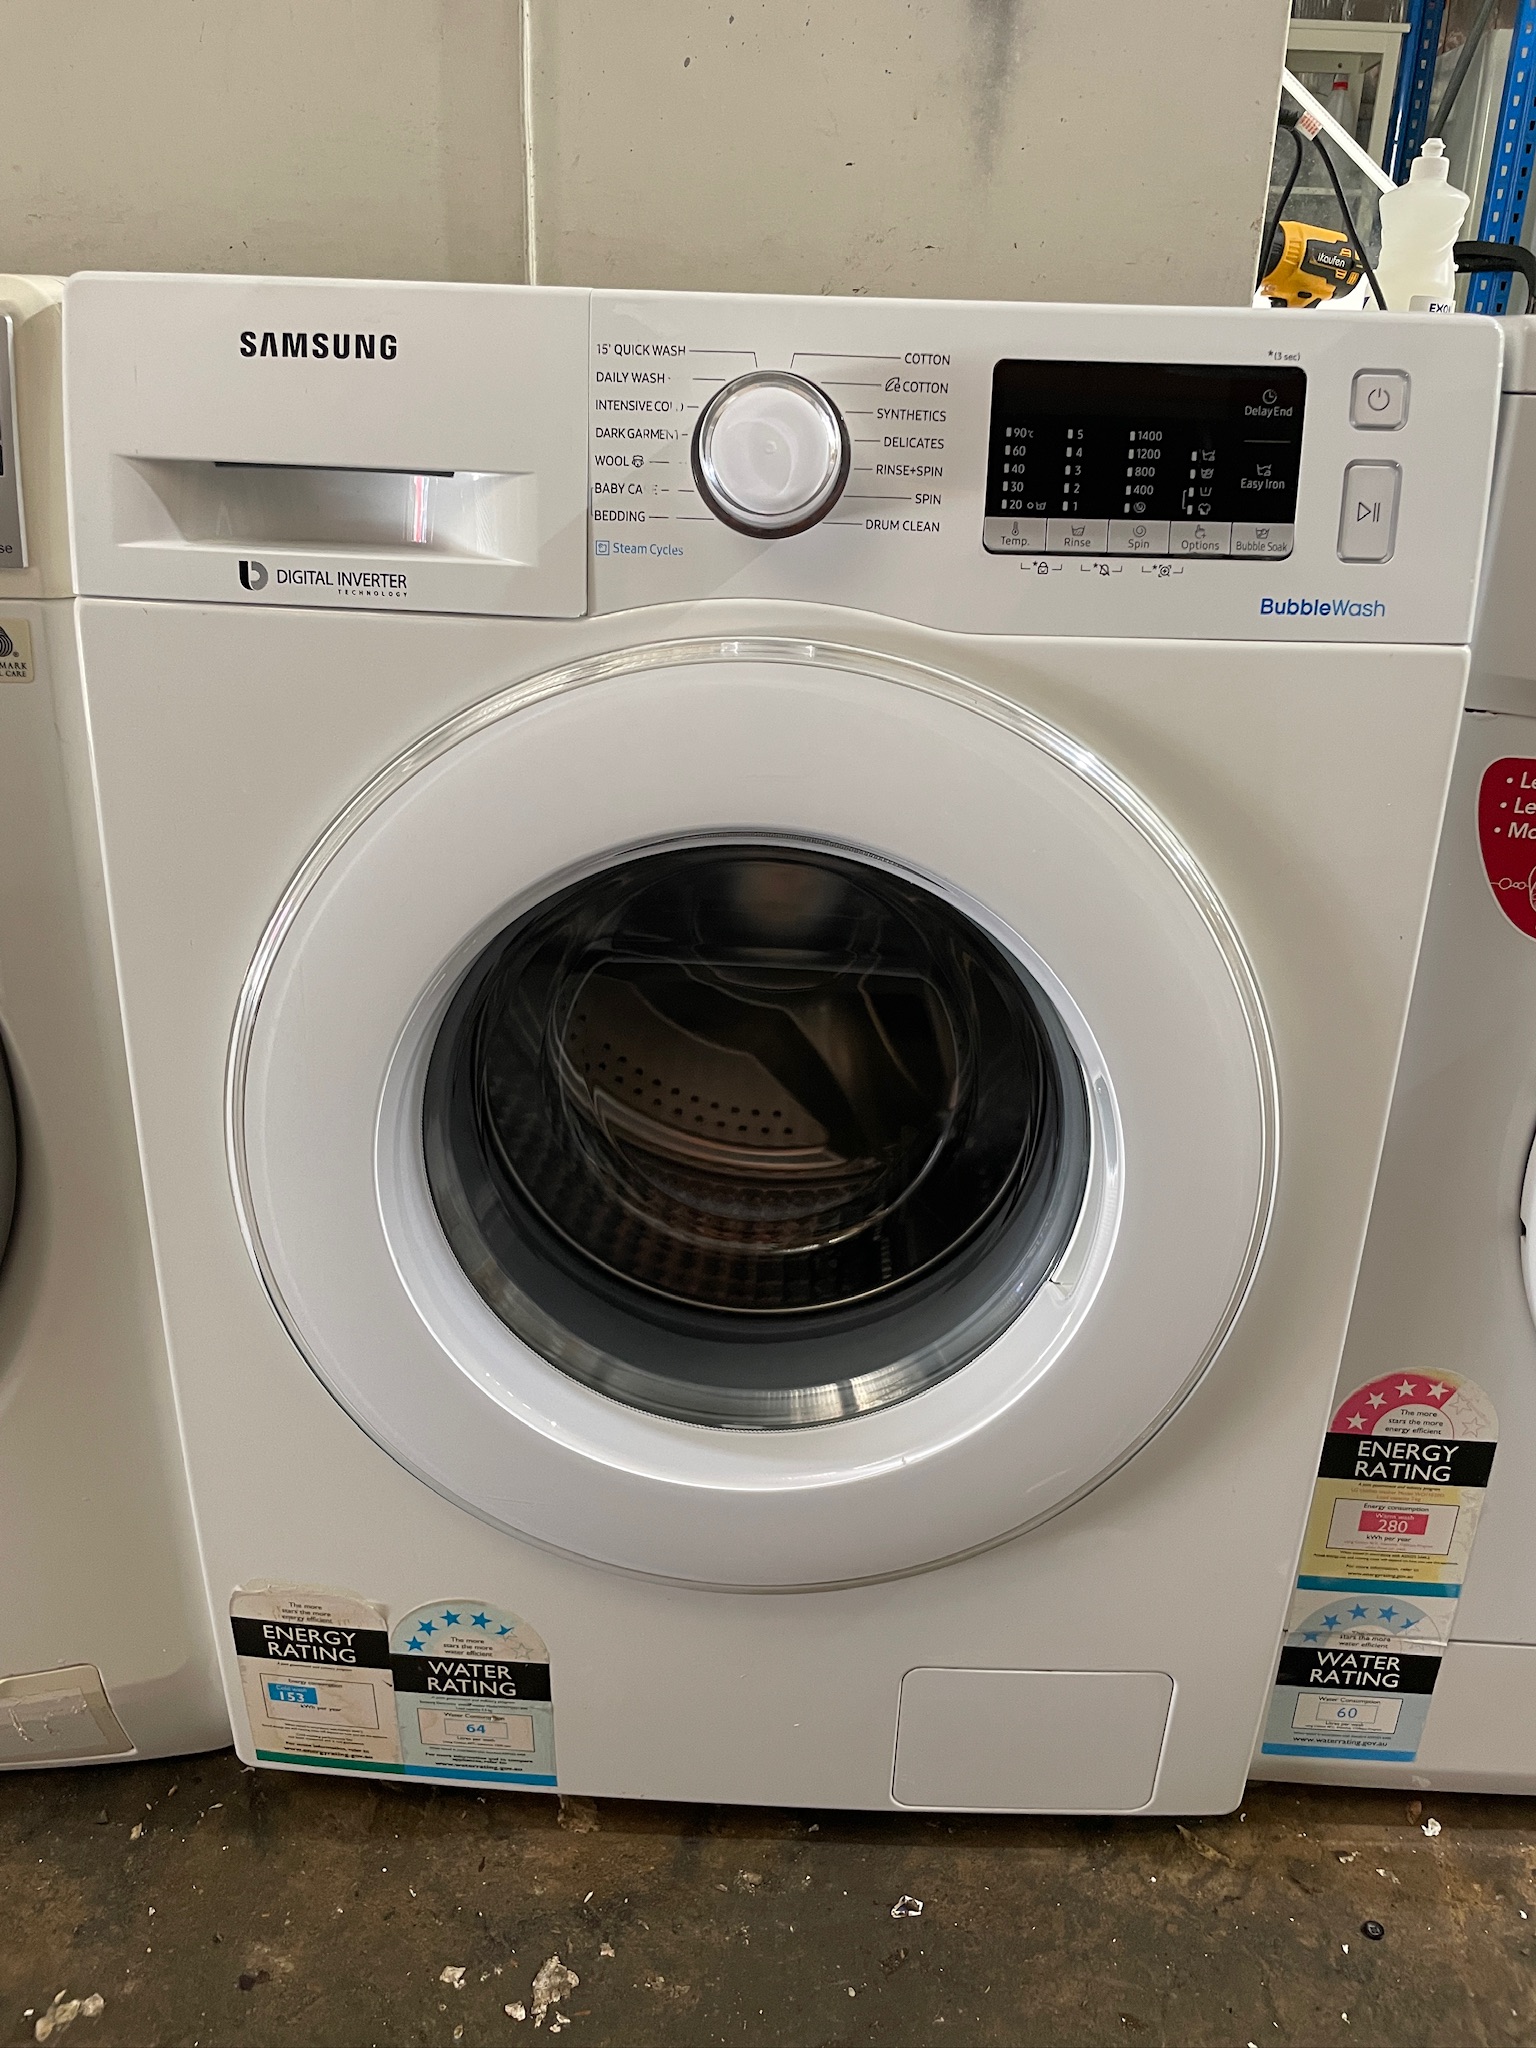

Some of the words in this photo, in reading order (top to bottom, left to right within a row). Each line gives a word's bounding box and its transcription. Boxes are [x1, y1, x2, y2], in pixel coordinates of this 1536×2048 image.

[239, 331, 398, 360] SAMSUNG
[597, 343, 611, 355] 15'
[614, 344, 650, 357] QUICK
[652, 345, 686, 356] WASH
[904, 352, 951, 366] COTTON
[596, 371, 629, 383] DAILY
[631, 372, 665, 384] WASH
[595, 399, 653, 411] INTENSIVE
[876, 408, 947, 422] SYNTHETICS
[595, 427, 626, 439] DARK
[1077, 429, 1084, 440] 5
[1137, 430, 1163, 441] 1400
[883, 436, 945, 450] DELICATES
[1012, 445, 1026, 457] 60
[1075, 447, 1083, 458] 4
[1136, 448, 1161, 460] 1200
[594, 455, 630, 467] WOOL
[876, 464, 943, 477] RINSE+SPIN
[1011, 463, 1025, 474] 40
[1074, 465, 1082, 476] 3
[1134, 466, 1156, 477] 800
[594, 482, 625, 494] BABY
[1010, 481, 1024, 492] 30
[1073, 483, 1080, 494] 2
[1133, 484, 1154, 495] 400
[1240, 478, 1264, 491] Easy
[1265, 479, 1285, 489] Iron
[915, 493, 942, 505] SPIN
[1009, 499, 1023, 510] 20
[1072, 501, 1078, 512] 1
[594, 510, 646, 522] BEDDING
[865, 519, 900, 531] DRUM
[902, 520, 940, 532] CLEAN
[1001, 536, 1030, 548] Temp.
[1064, 537, 1091, 547] Rinse
[1128, 539, 1150, 551] Spin
[1181, 540, 1220, 552] Options
[1236, 541, 1265, 552] Bubble
[1267, 541, 1288, 552] Soak
[613, 542, 647, 554] Steam
[649, 544, 684, 557] Cycles
[276, 569, 334, 586] DIGITAL
[337, 571, 407, 589] INVERTER
[338, 589, 408, 597] TECHNOLOGY
[1260, 598, 1386, 617] BubbleWash
[1400, 1408, 1415, 1416] The
[1416, 1410, 1438, 1418] more
[1408, 1418, 1421, 1426] the
[1384, 1426, 1411, 1434] energy
[1412, 1426, 1442, 1435] efficient
[1357, 1440, 1460, 1463] ENERGY
[1354, 1460, 1452, 1482] RATING
[1363, 1502, 1386, 1511] Energy
[1387, 1504, 1430, 1512] consumption
[1377, 1519, 1409, 1533] 280
[262, 1624, 356, 1646] ENERGY
[267, 1641, 357, 1663] RATING
[466, 1650, 493, 1658] efficient
[1317, 1650, 1400, 1671] WATER
[428, 1660, 513, 1680] WATER
[1309, 1668, 1400, 1688] RATING
[427, 1676, 517, 1697] RATING
[279, 1690, 305, 1703] 153
[1337, 1707, 1358, 1718] 60
[466, 1723, 486, 1734] 64
